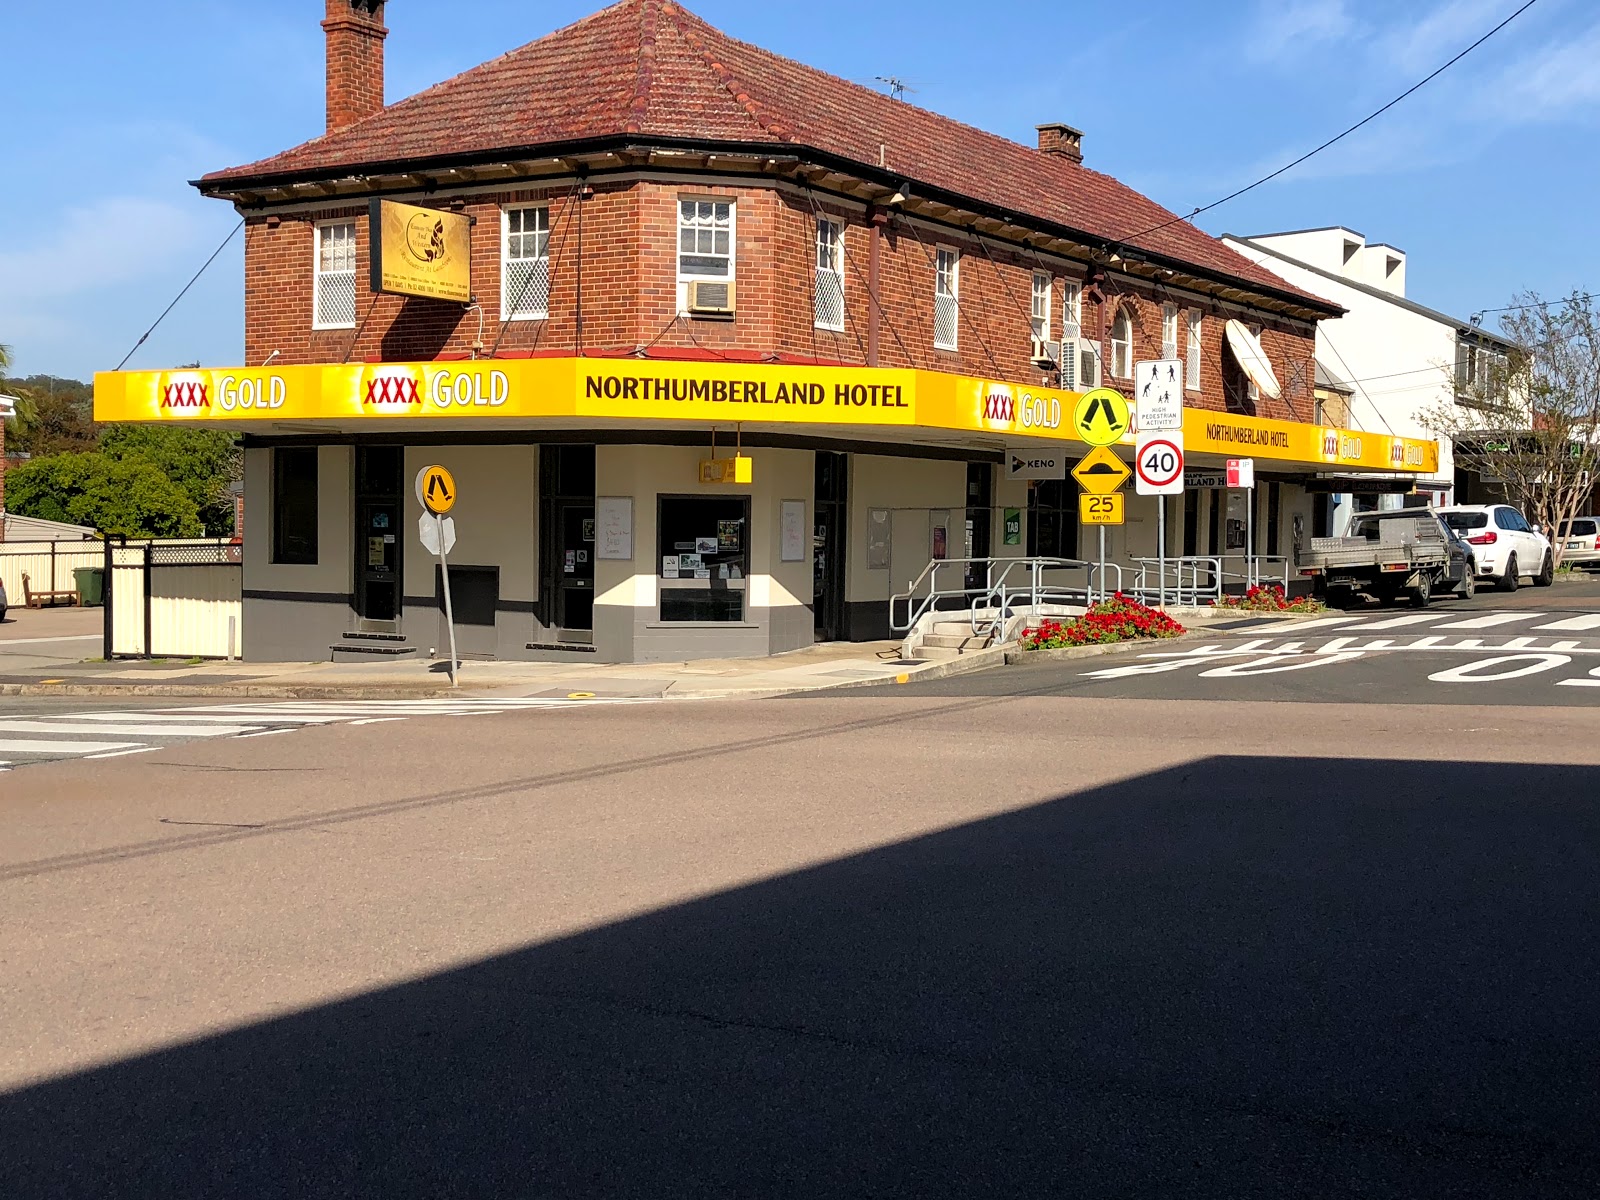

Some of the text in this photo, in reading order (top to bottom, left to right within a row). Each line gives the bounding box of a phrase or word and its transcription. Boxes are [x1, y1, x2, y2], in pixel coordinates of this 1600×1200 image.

[160, 375, 287, 411] XXXX GOLD
[362, 369, 509, 409] XXXX GOLD
[585, 375, 909, 408] NORTHUMBERLAND HOTEL
[982, 393, 1062, 430] XXXX GOLD
[1206, 422, 1289, 448] NORTHUMBERLAND HOTEL
[1322, 434, 1362, 460] XXXX GOLD
[1028, 460, 1055, 468] KENO
[1144, 452, 1174, 473] 40
[1390, 442, 1424, 466] XXXX GOLD
[1088, 497, 1114, 513] 25
[1007, 522, 1018, 533] TAB
